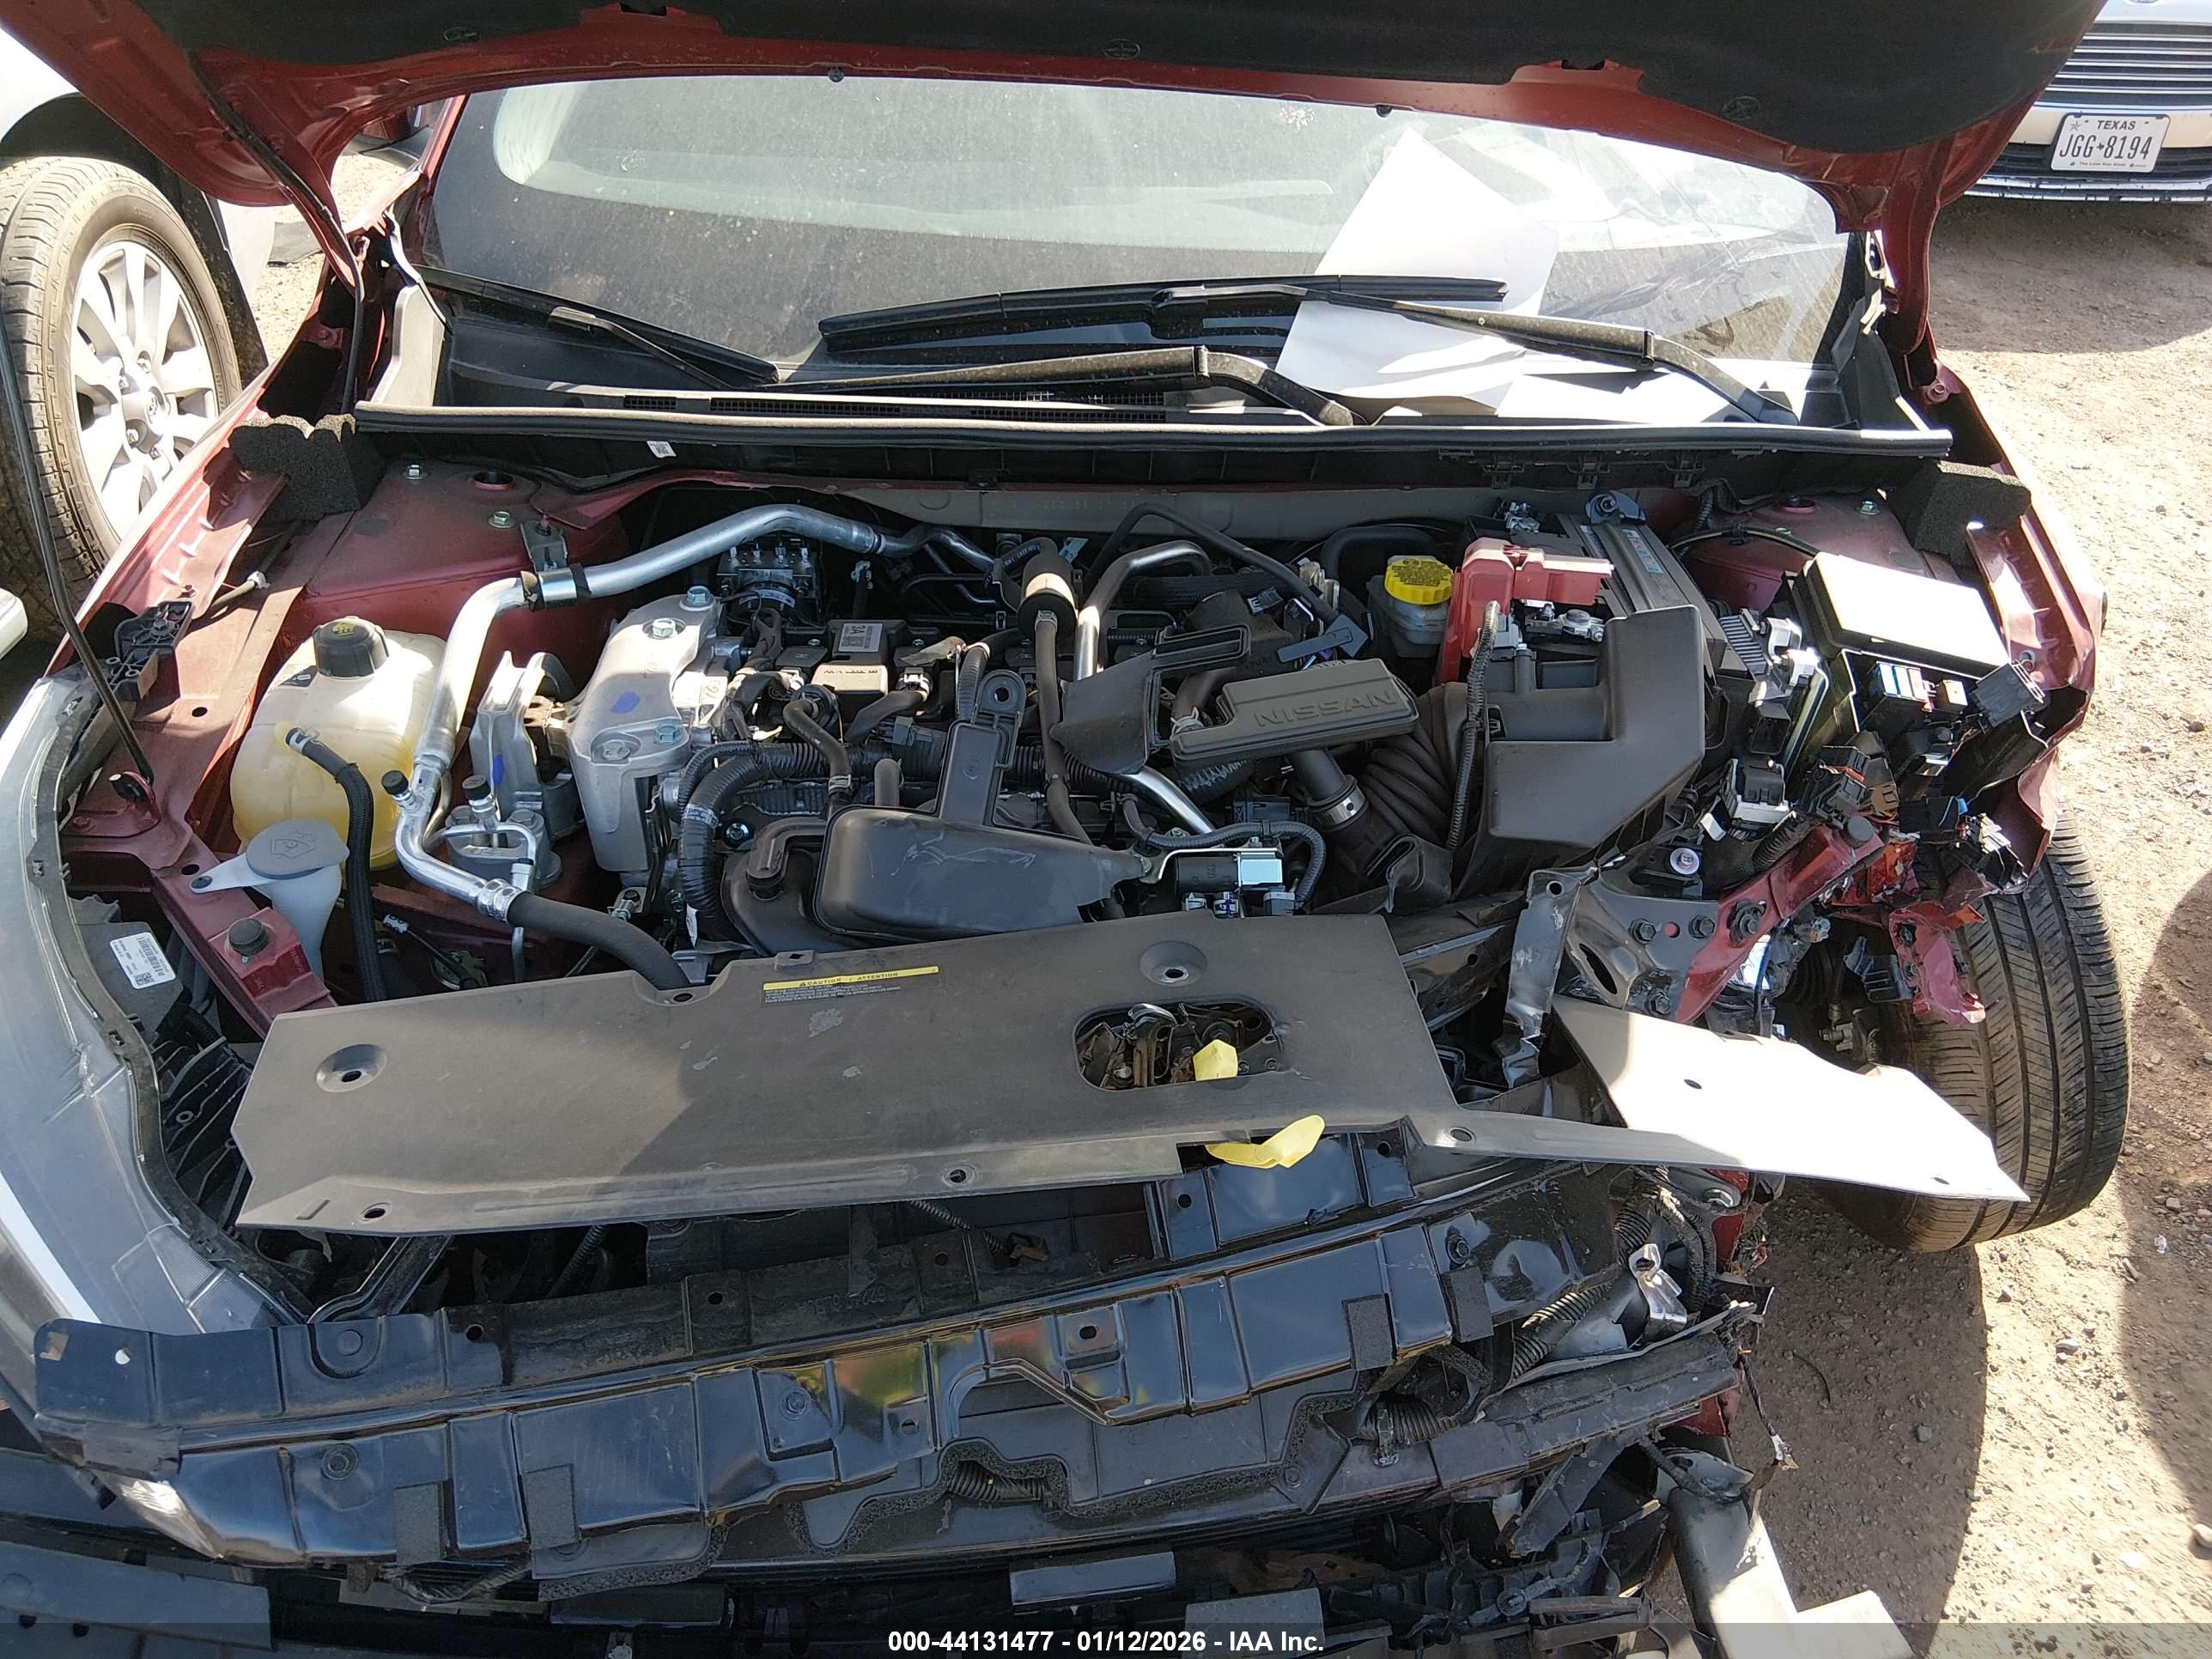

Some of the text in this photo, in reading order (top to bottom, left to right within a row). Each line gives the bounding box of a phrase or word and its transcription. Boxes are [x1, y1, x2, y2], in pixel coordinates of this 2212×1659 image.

[2097, 120, 2136, 130] TEXAS
[850, 625, 866, 635] 3A
[1254, 690, 1397, 727] NISSAN
[807, 977, 842, 986] CAUTION
[857, 972, 898, 981] ATTENTION
